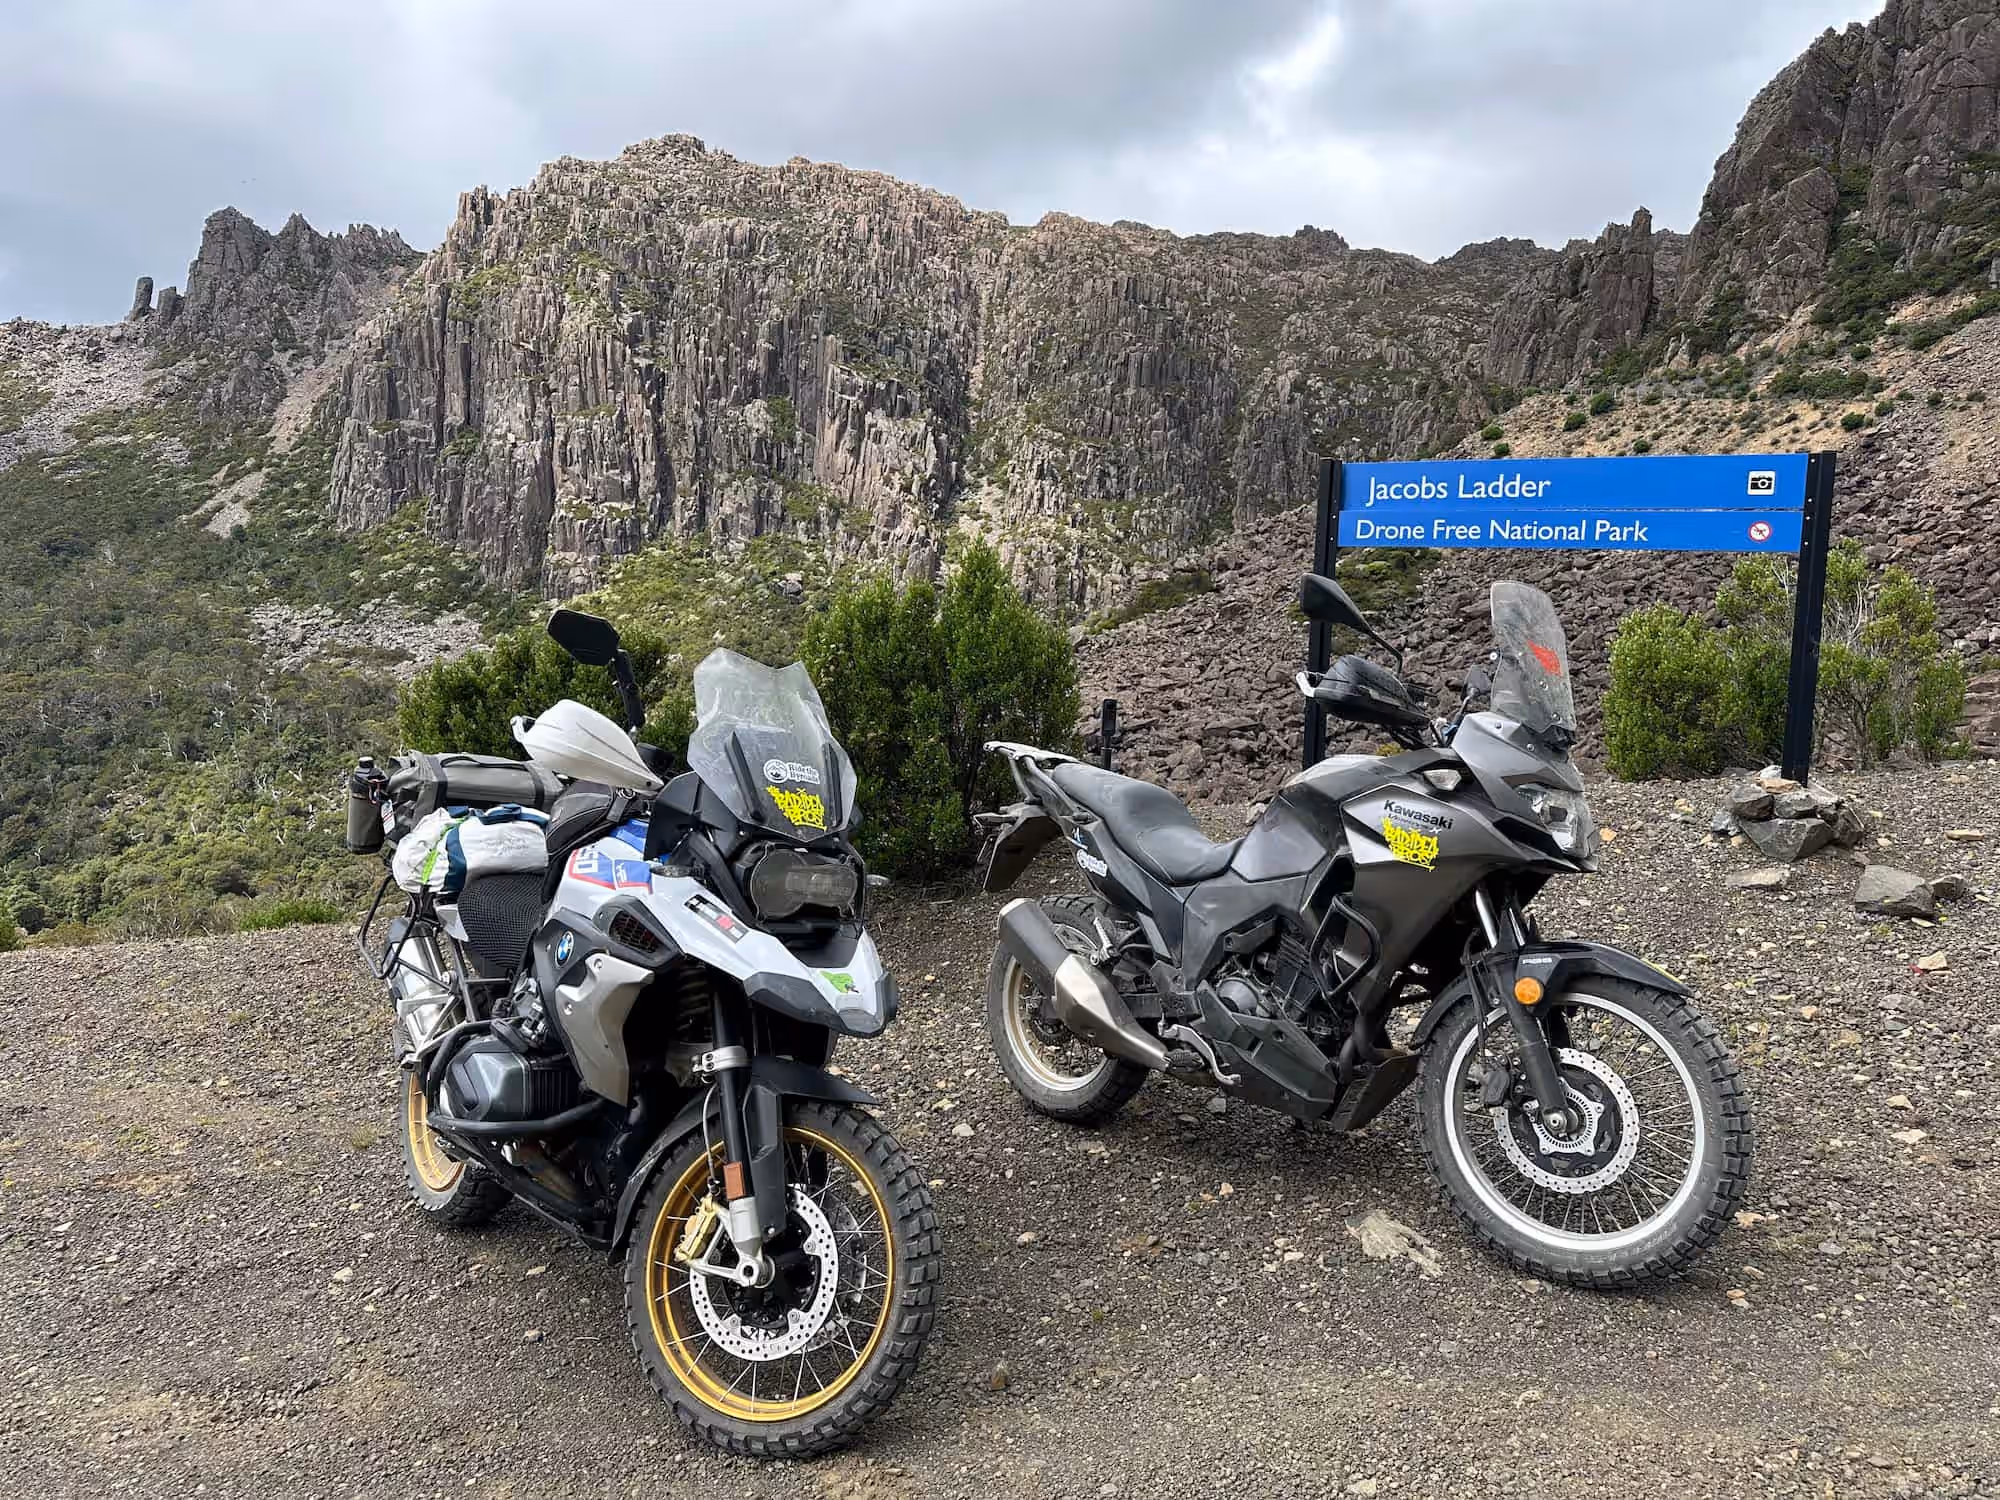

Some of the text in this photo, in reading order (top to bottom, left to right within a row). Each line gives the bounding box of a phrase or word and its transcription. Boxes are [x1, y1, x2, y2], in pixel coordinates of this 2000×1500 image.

[1365, 473, 1551, 507] Jacobs Ladder
[1356, 519, 1648, 542] Drone Free National Park
[1384, 800, 1454, 829] Kawasaki
